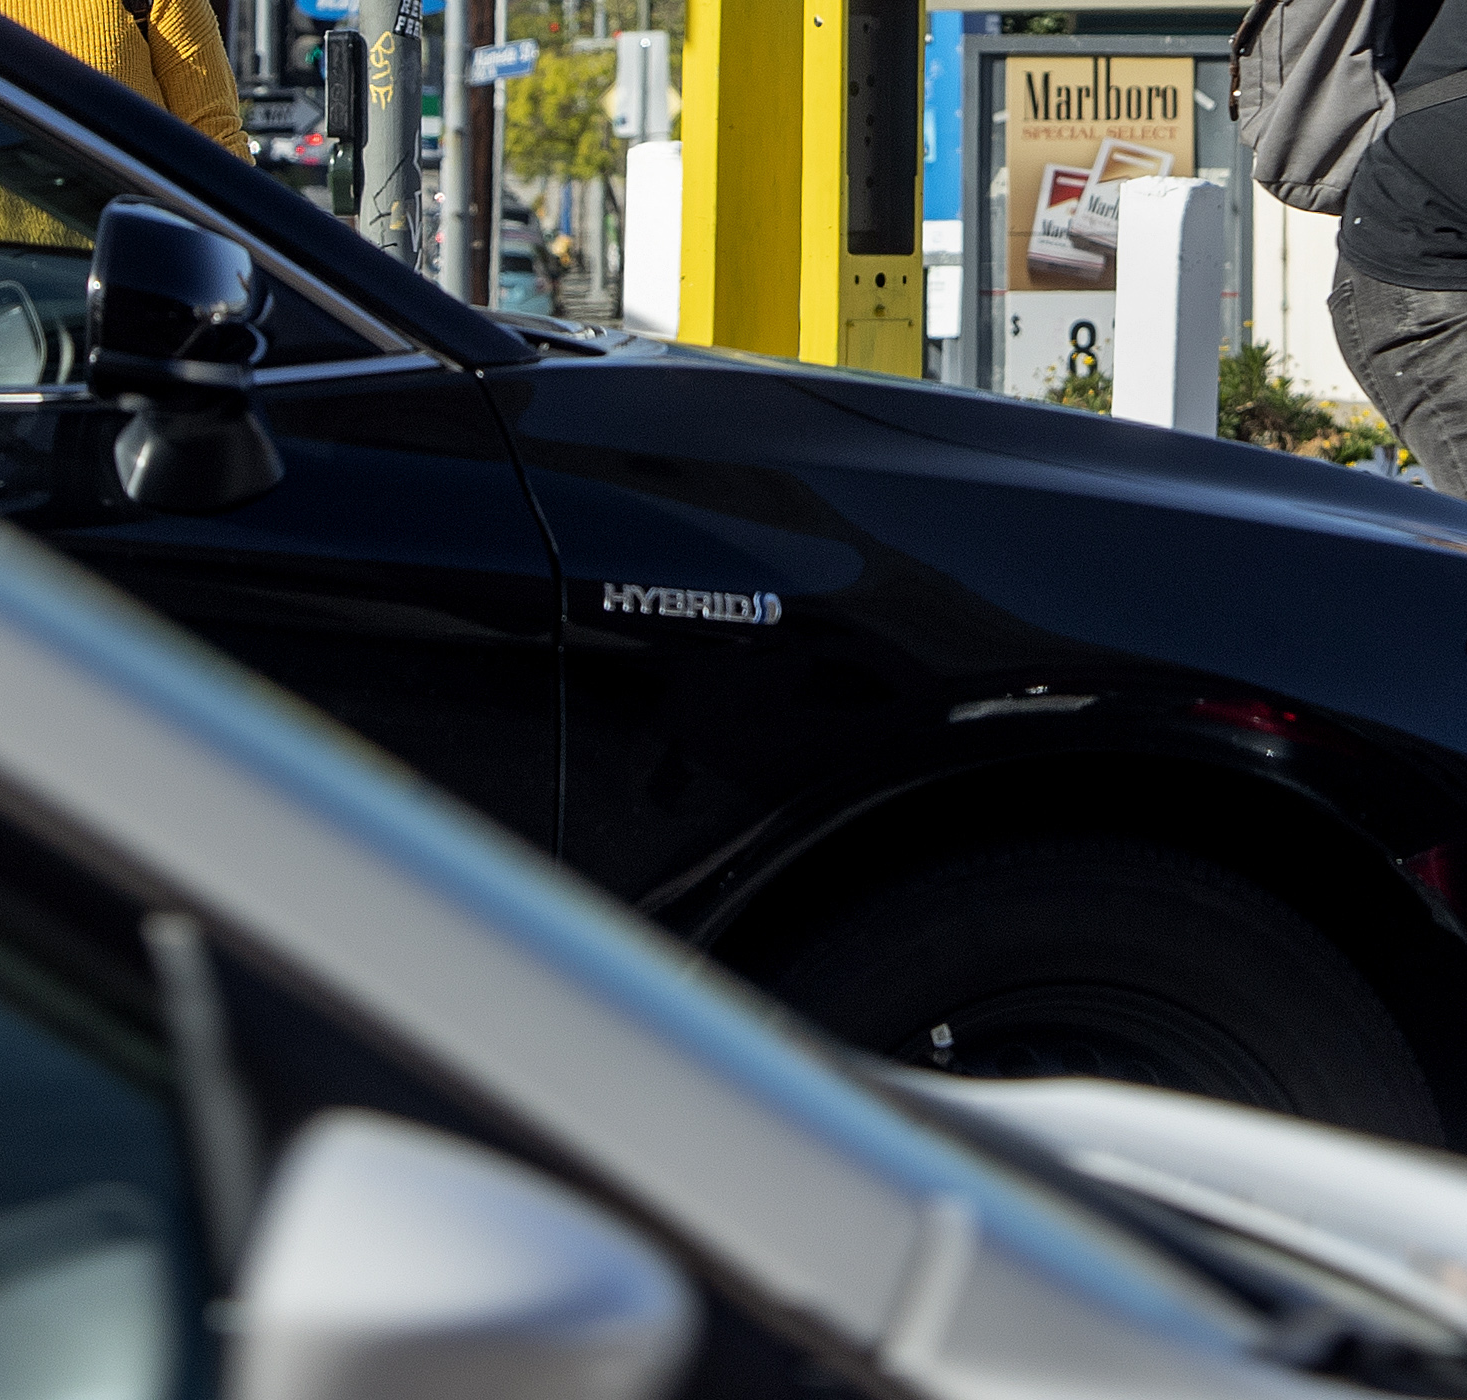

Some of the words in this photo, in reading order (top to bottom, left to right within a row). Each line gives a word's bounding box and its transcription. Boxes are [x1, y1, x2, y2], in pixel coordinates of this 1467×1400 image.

[1024, 57, 1179, 123] Marlboro
[1021, 125, 1096, 141] SPECIAL
[1105, 125, 1180, 140] SELECT
[603, 582, 755, 624] HYBRID
